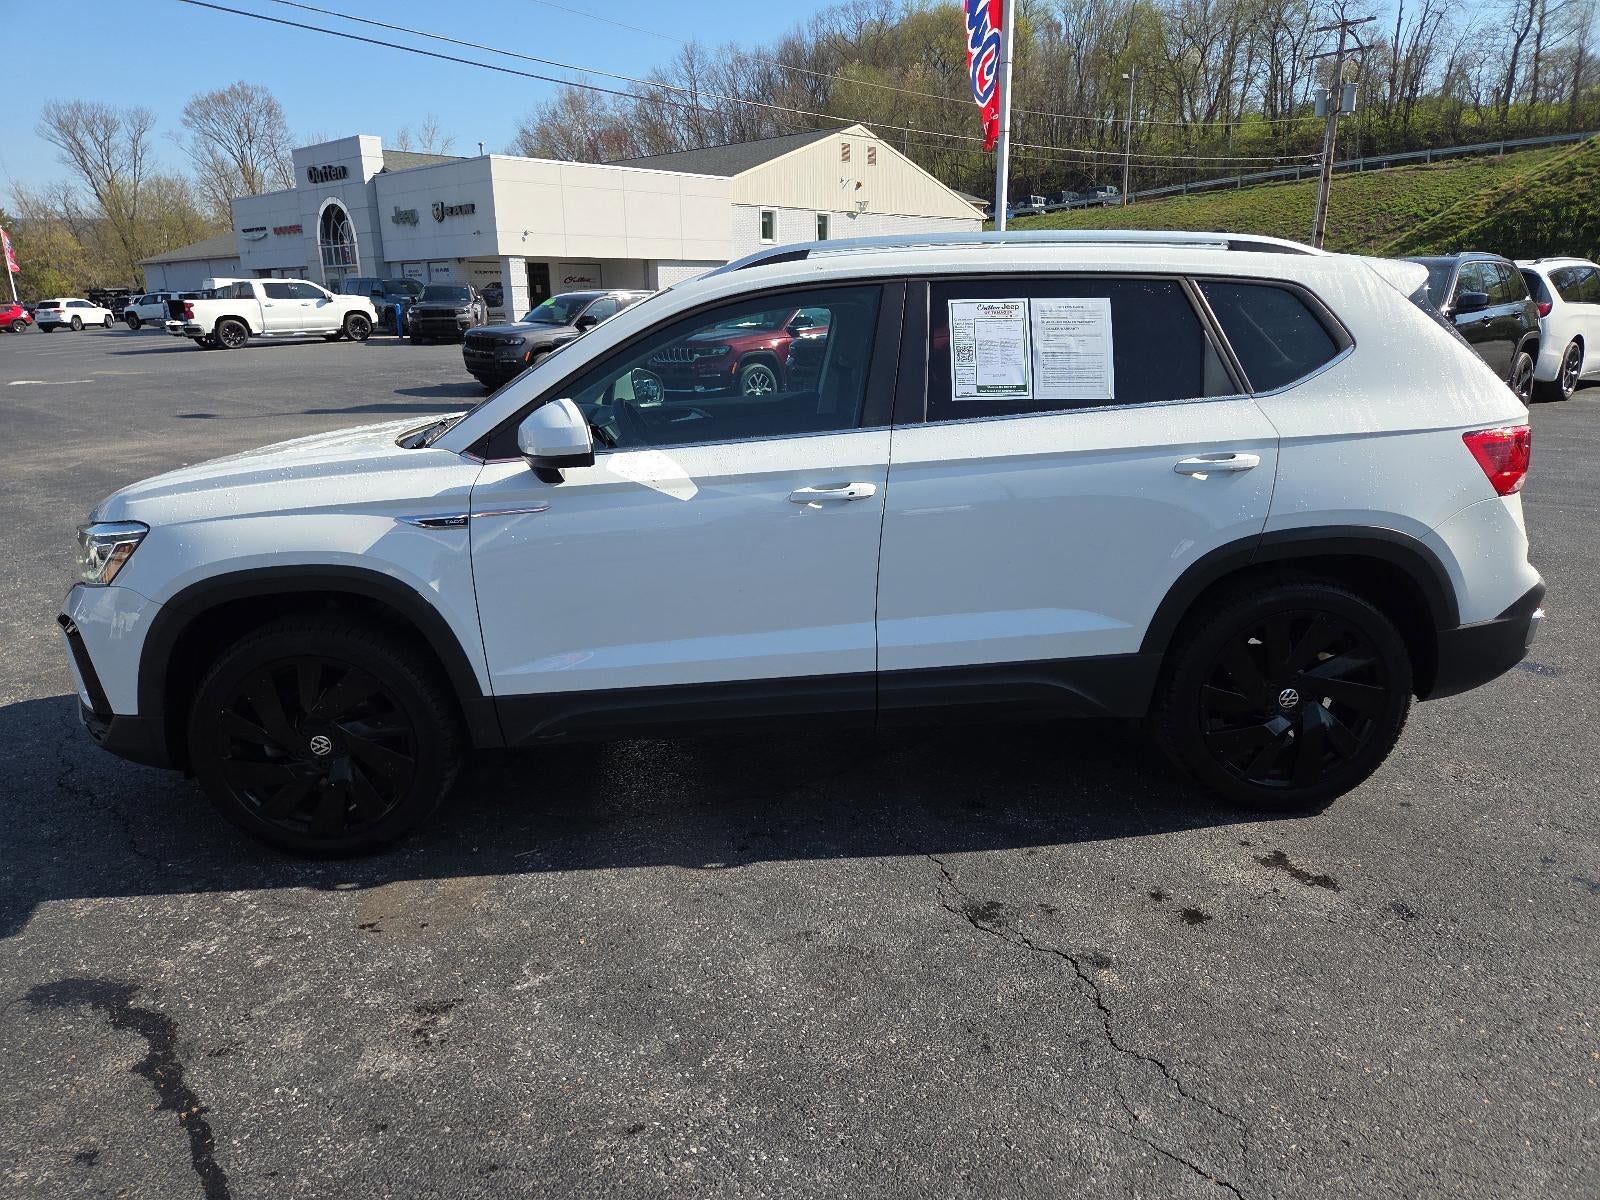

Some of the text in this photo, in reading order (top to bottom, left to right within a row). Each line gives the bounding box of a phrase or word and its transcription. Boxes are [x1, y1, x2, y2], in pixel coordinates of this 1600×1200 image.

[307, 165, 349, 183] Outten
[444, 204, 475, 216] RAM
[1001, 303, 1020, 311] Jeep
